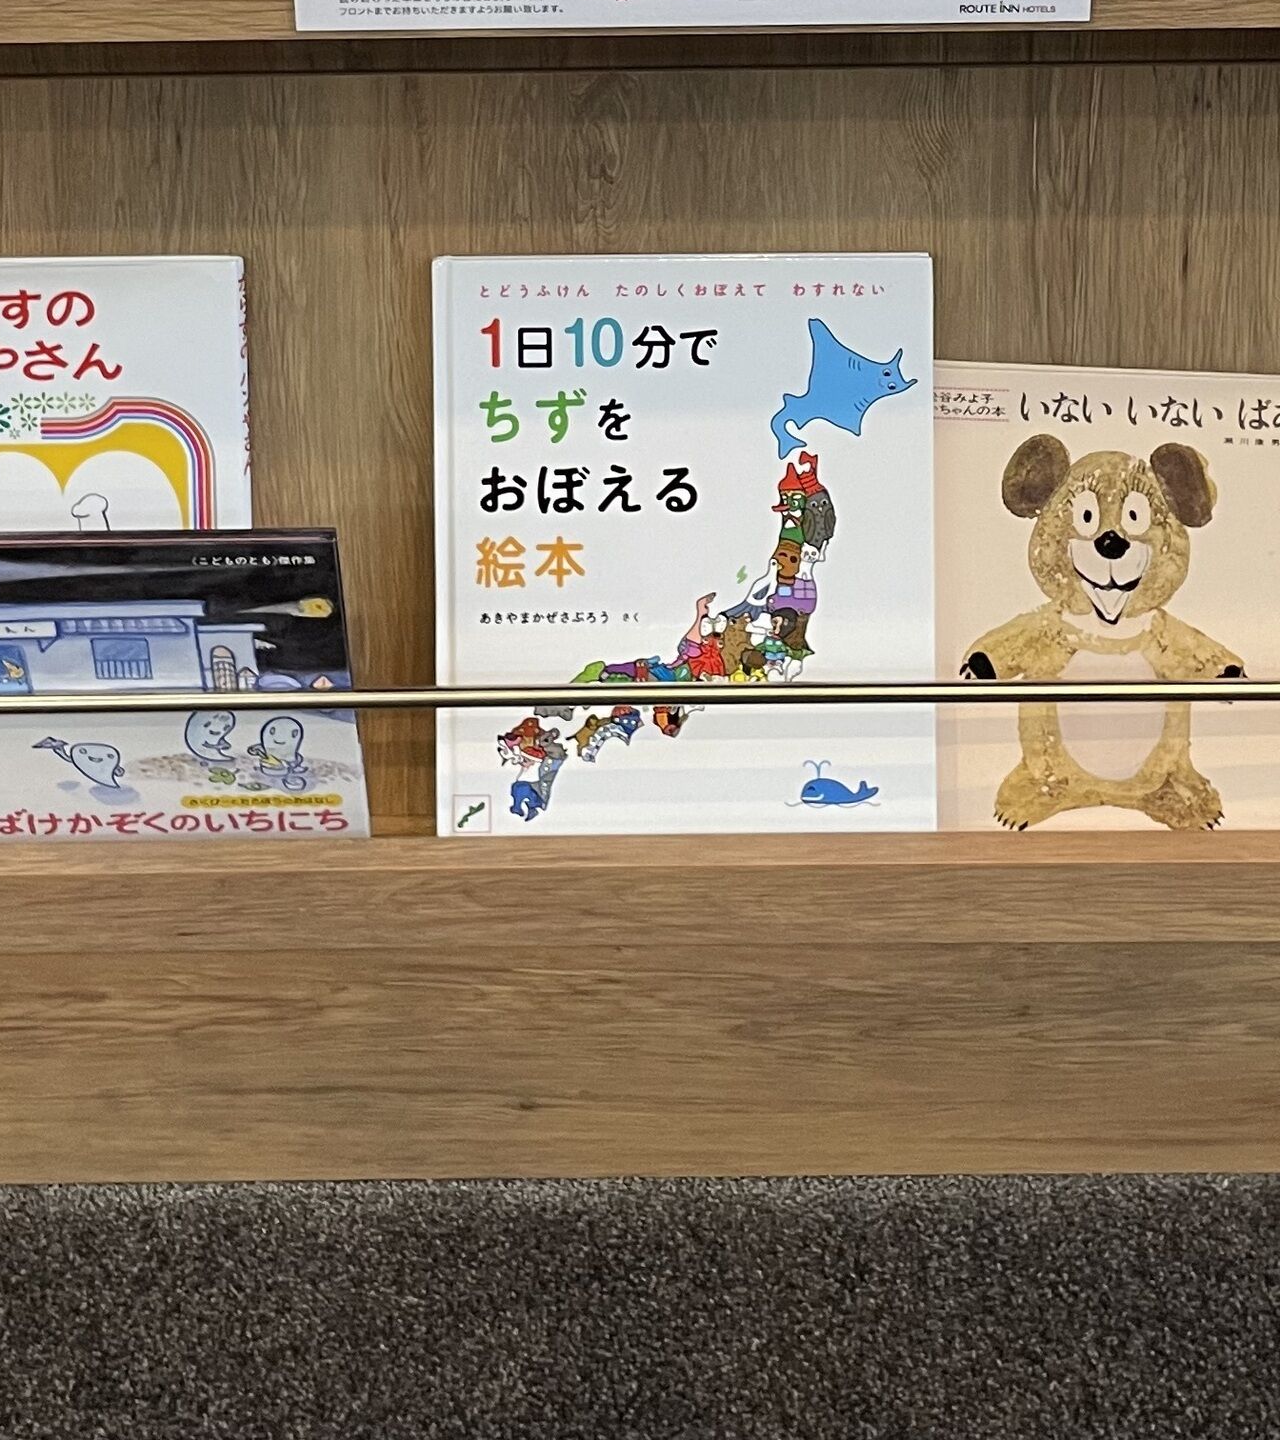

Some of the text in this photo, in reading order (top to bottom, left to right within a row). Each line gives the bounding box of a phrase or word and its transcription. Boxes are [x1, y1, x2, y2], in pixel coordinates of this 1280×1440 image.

[959, 4, 997, 14] ROUTE
[1022, 5, 1056, 14] HOTELS
[479, 282, 888, 299] とどうふけん たのしくおぼえて わすれない
[480, 316, 719, 369] 1日10分で
[478, 387, 632, 444] ちずを
[1019, 391, 1112, 424] いない
[1128, 395, 1223, 427] いない
[479, 464, 699, 515] おぼえる
[475, 535, 586, 589] 絵本
[479, 611, 610, 625] あきやまかぜさぶろう
